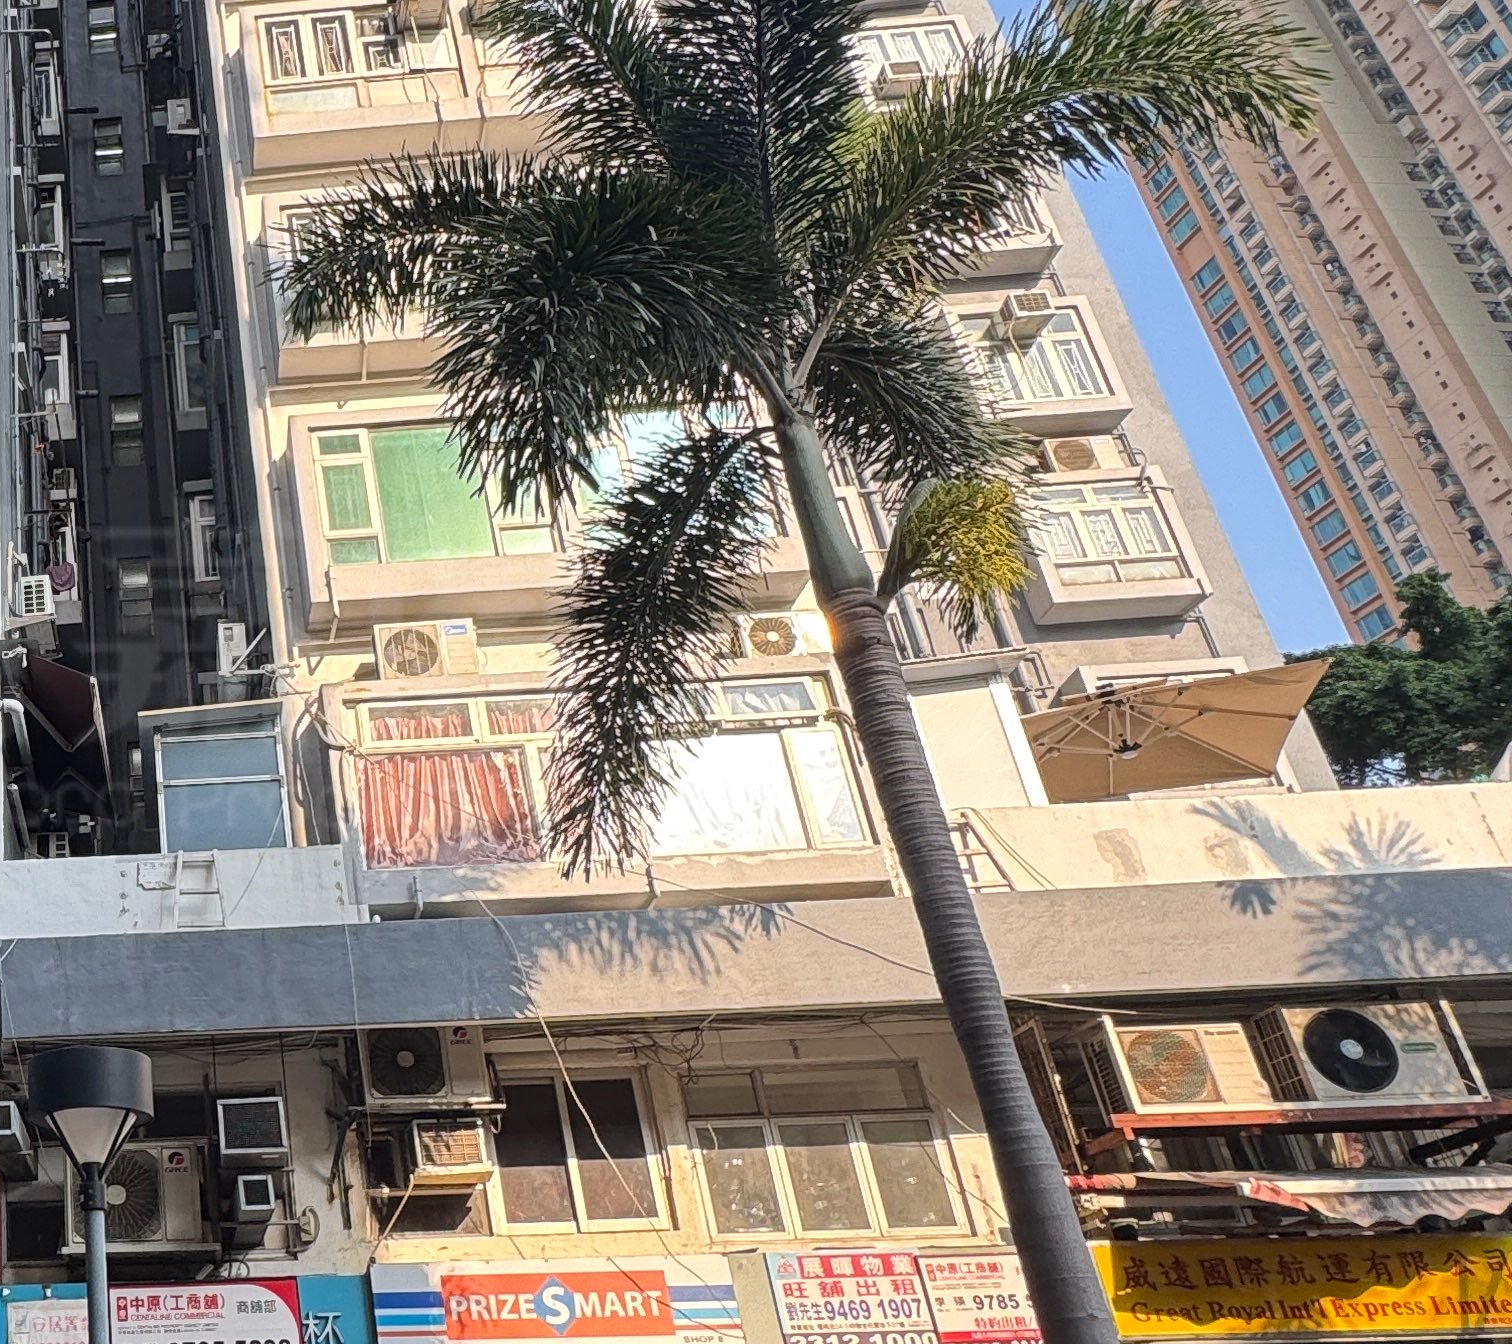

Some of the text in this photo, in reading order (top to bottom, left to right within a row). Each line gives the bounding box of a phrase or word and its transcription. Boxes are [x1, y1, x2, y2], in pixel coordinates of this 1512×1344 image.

[782, 1278, 918, 1299] 旺舖出租
[823, 1299, 872, 1322] 9469
[877, 1298, 922, 1320] 1907
[973, 1293, 1020, 1311] 9785
[1130, 1301, 1204, 1324] Great
[1206, 1299, 1276, 1326] Royal
[1332, 1297, 1428, 1322] Express
[683, 1335, 715, 1344] SHOP
